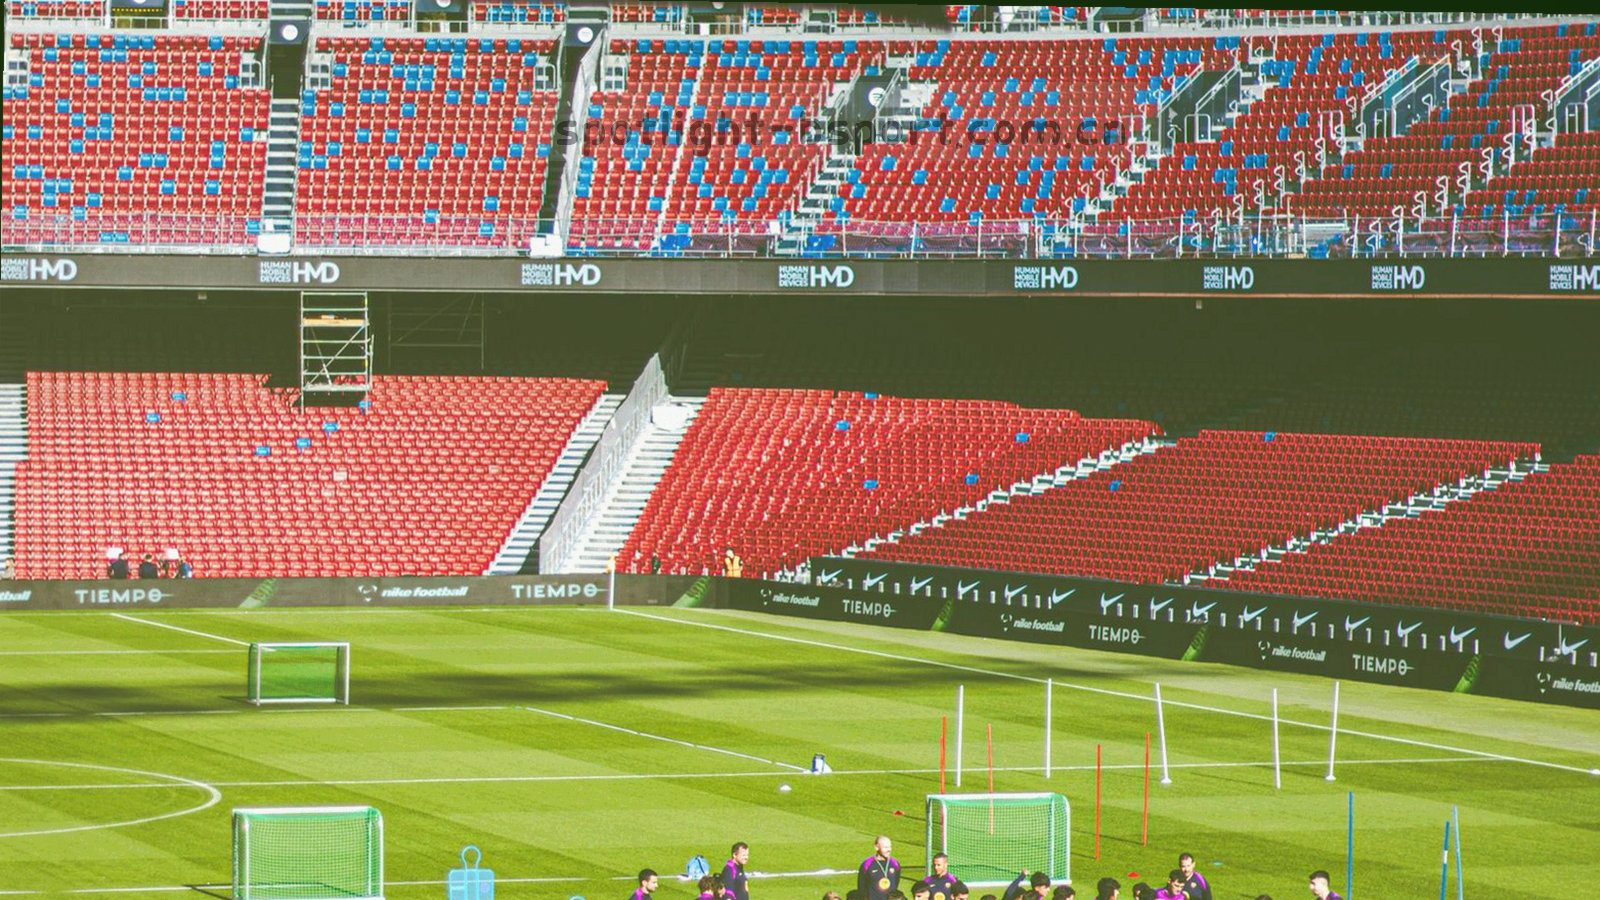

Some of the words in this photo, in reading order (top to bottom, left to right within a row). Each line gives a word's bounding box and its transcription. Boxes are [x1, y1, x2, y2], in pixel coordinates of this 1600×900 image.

[30, 258, 77, 280] HMD
[293, 262, 340, 283] HMD
[554, 264, 601, 285] HMD
[810, 266, 854, 287] HMD
[1041, 266, 1078, 288] HMD
[1225, 266, 1254, 289] HMD
[1394, 266, 1425, 289] HMD
[1550, 281, 1572, 289] DEVICES
[75, 588, 172, 603] TIEMPO
[382, 587, 412, 597] nike
[413, 586, 469, 596] football
[511, 583, 606, 598] TIEMPO
[773, 593, 790, 604] nike
[790, 594, 820, 606] football
[842, 600, 895, 618] TIEMPO
[1013, 618, 1032, 628] nike
[1032, 620, 1065, 632] football
[1089, 625, 1145, 644] TIEMPO
[1272, 646, 1290, 657] nike
[1292, 647, 1326, 662] football
[1352, 654, 1414, 676] TIEMPO
[1552, 678, 1574, 690] nike
